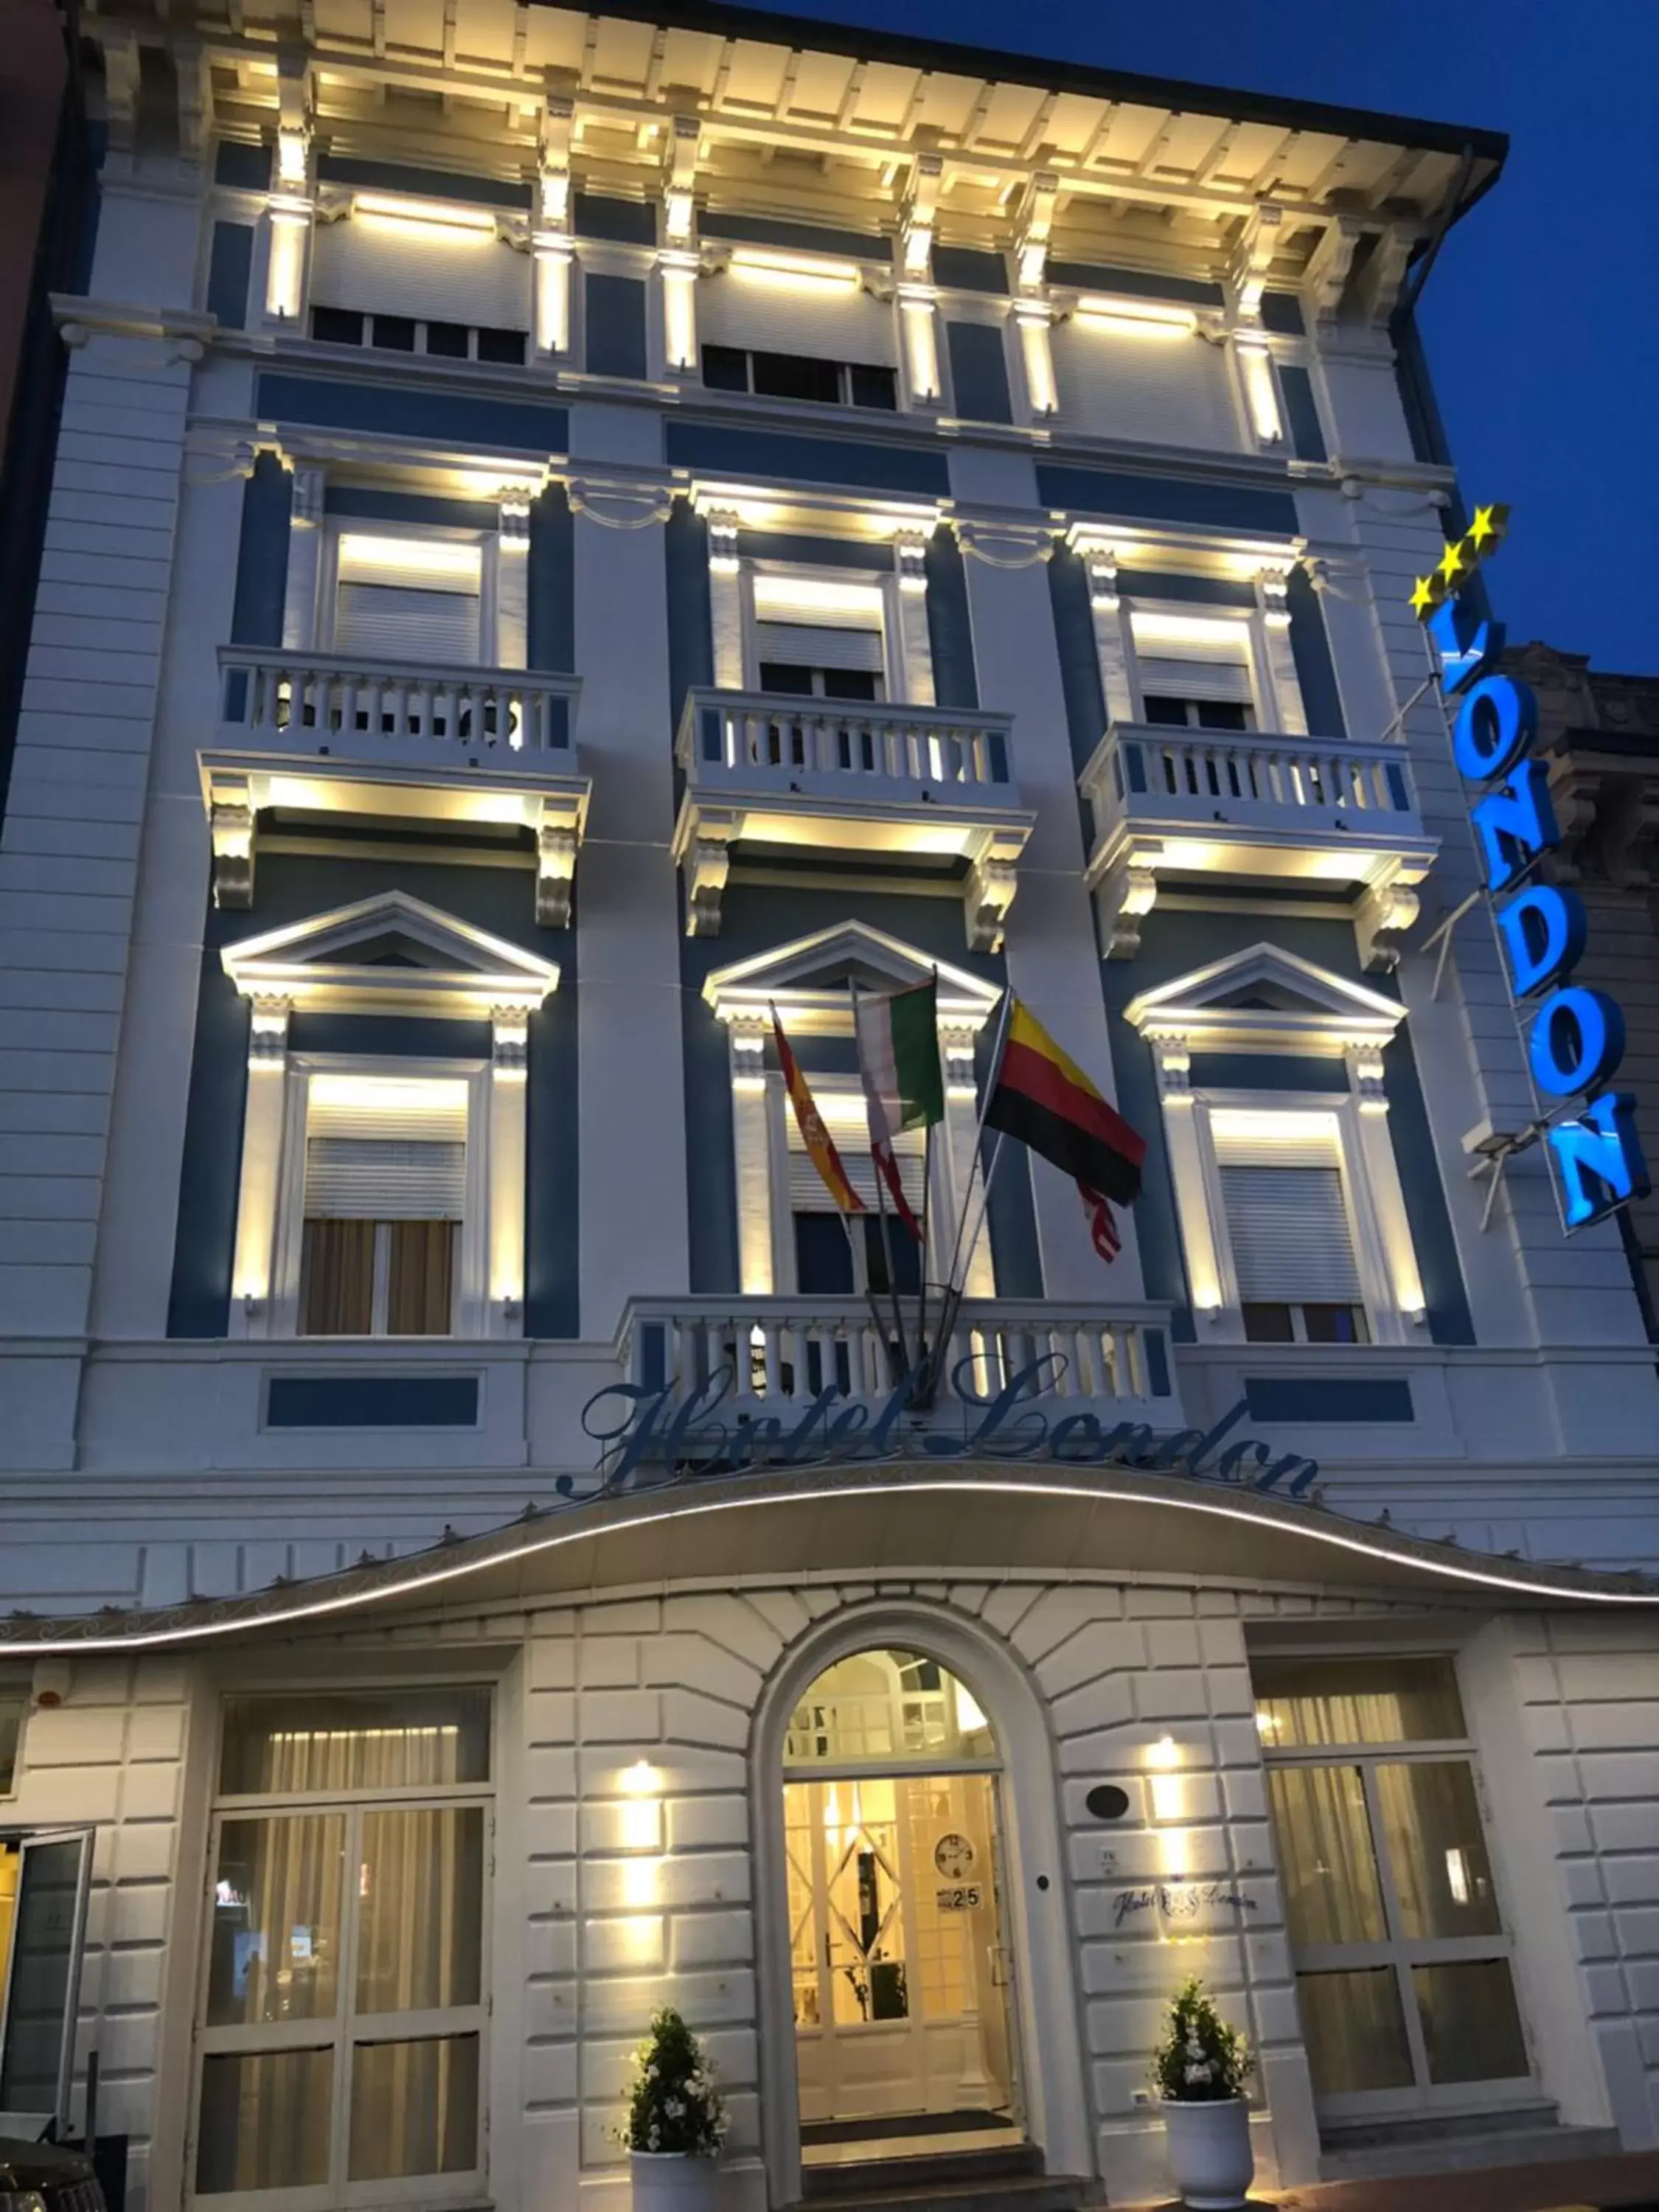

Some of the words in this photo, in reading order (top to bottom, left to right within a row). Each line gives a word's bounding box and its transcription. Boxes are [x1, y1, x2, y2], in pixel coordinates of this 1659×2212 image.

[1429, 596, 1652, 1229] LONDON
[555, 1352, 933, 1500] Hotel
[923, 1352, 1319, 1500] London
[953, 1888, 979, 1907] 25
